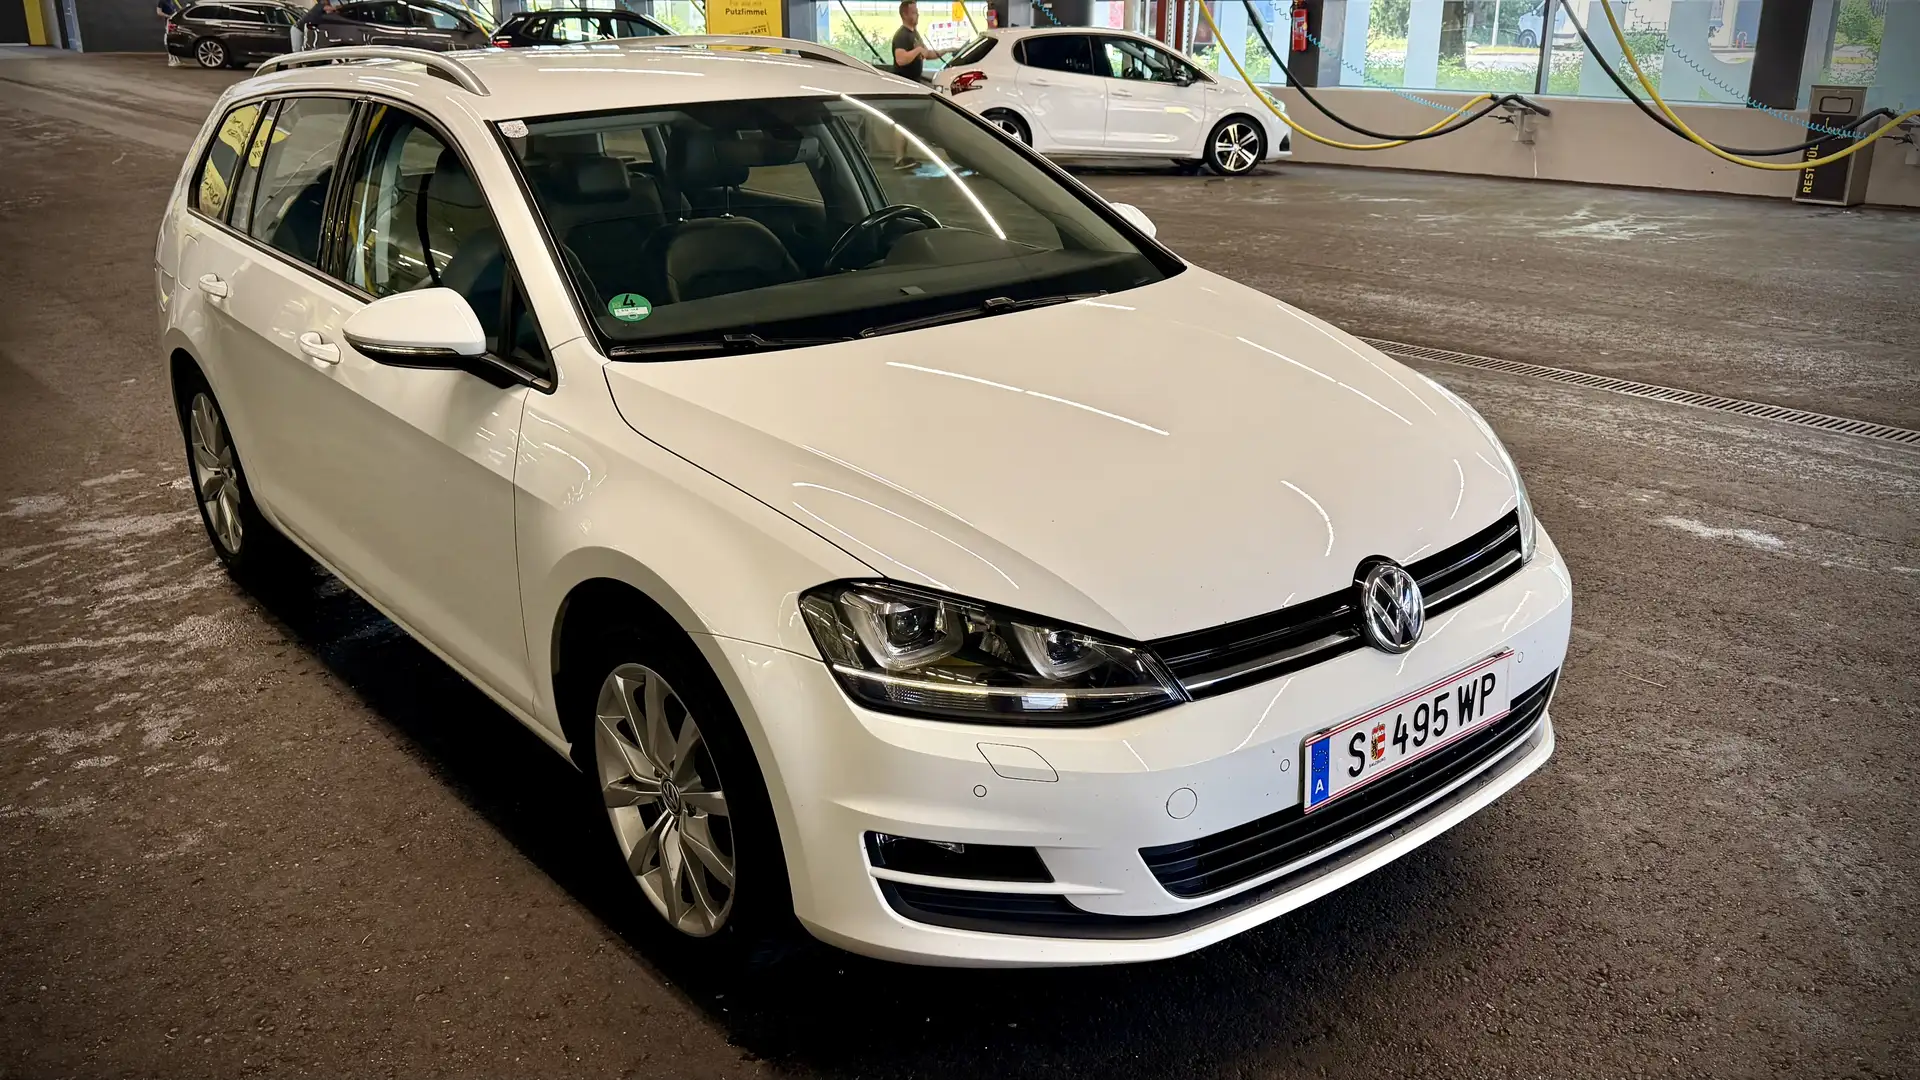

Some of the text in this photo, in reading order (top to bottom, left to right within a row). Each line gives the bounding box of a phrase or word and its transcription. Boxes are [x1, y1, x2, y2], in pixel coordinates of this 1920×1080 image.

[623, 294, 636, 307] 4
[1366, 566, 1423, 650] VW
[1348, 672, 1496, 778] S 495 WP
[1314, 779, 1324, 795] A
